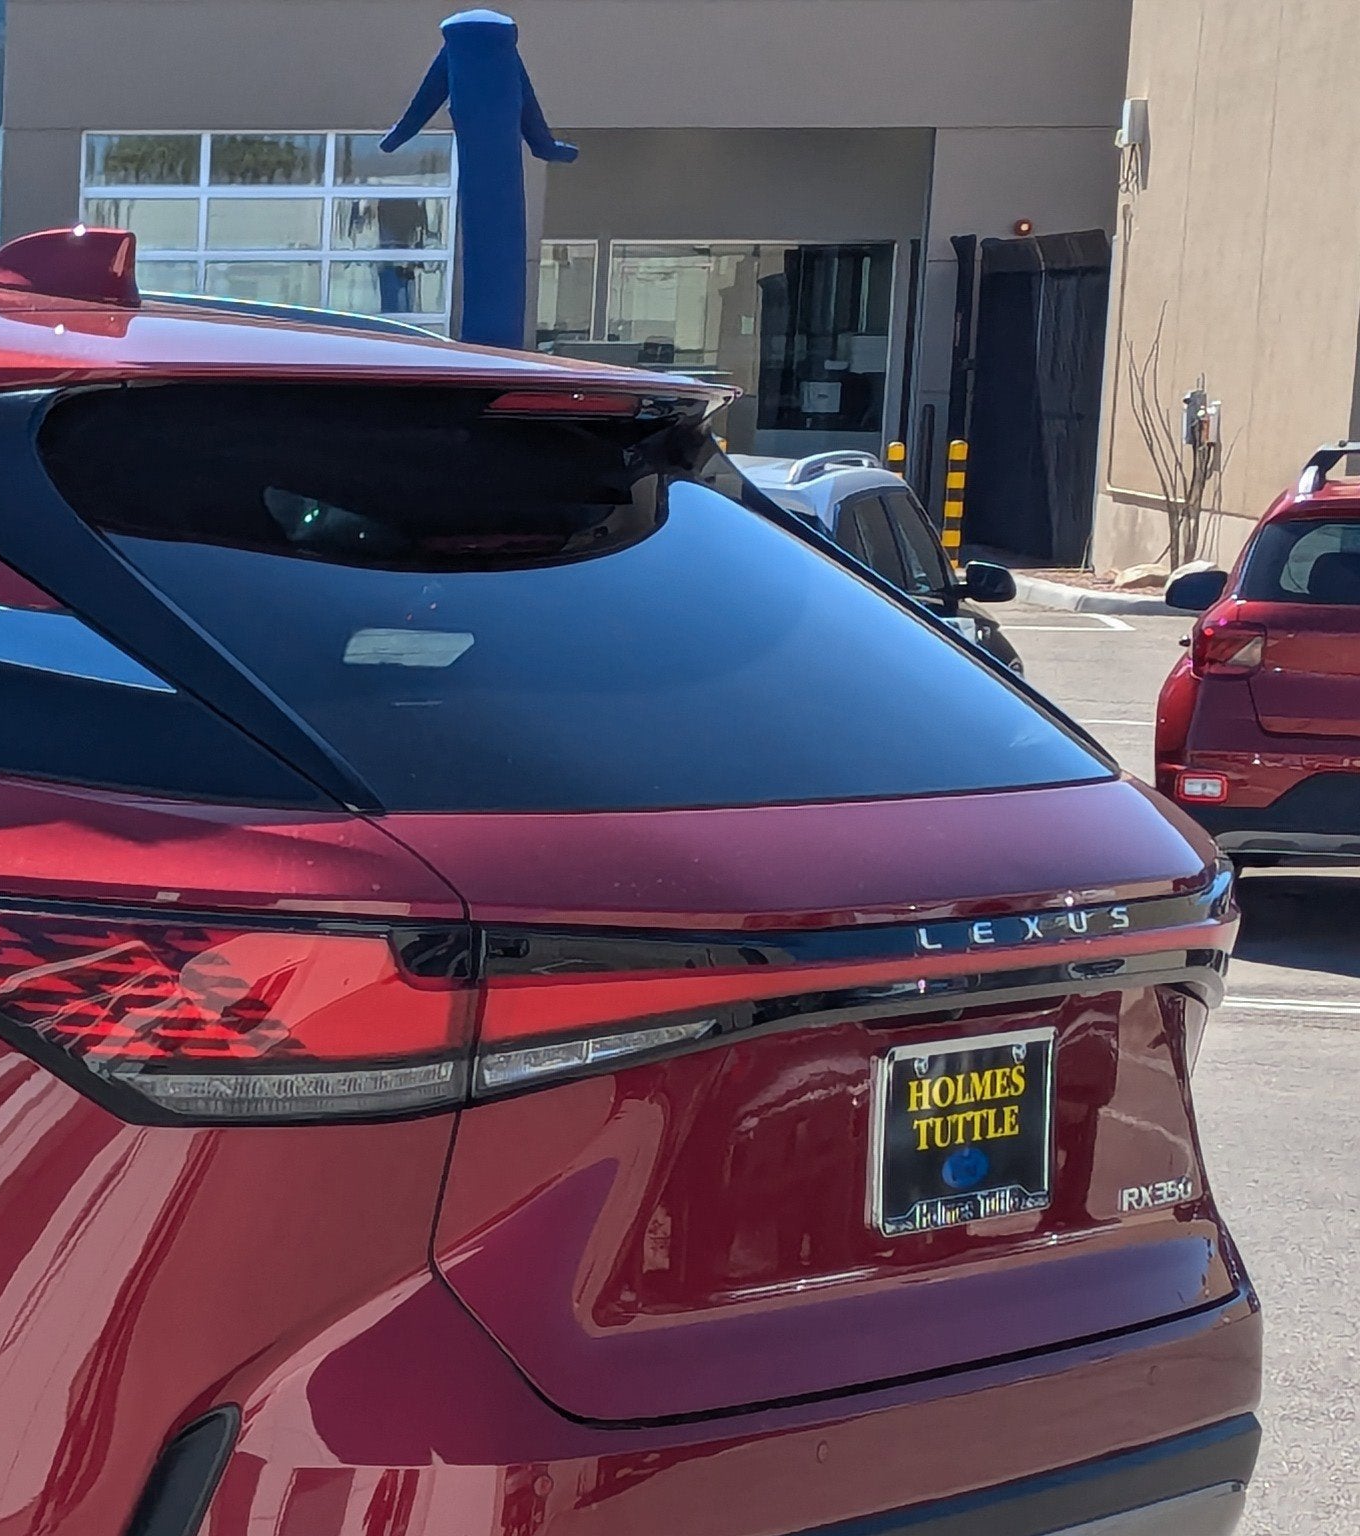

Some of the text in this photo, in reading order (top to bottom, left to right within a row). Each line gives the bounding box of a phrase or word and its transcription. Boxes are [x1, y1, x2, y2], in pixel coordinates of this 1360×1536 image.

[917, 906, 1130, 950] LEXUS
[908, 1065, 1026, 1112] HOLMES
[913, 1105, 1020, 1151] TUTTLE
